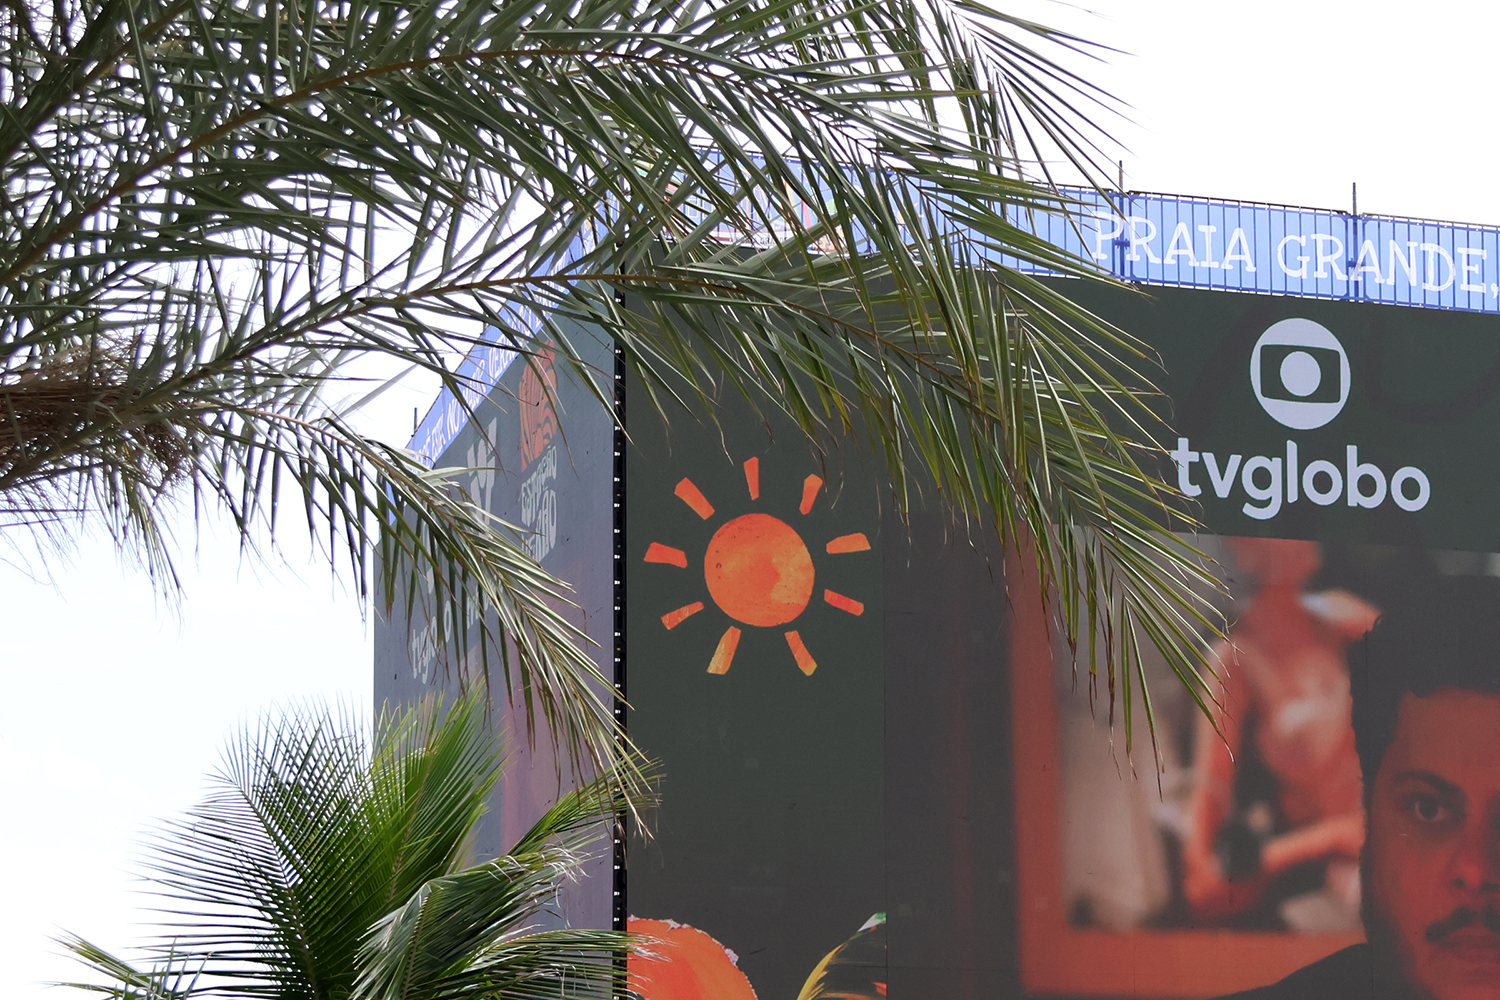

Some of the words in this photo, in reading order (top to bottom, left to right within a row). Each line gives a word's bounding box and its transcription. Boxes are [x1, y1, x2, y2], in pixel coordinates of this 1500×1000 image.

[1092, 211, 1256, 272] PRAIA
[1277, 234, 1500, 299] GRANDE,
[1170, 437, 1431, 521] tvglobo
